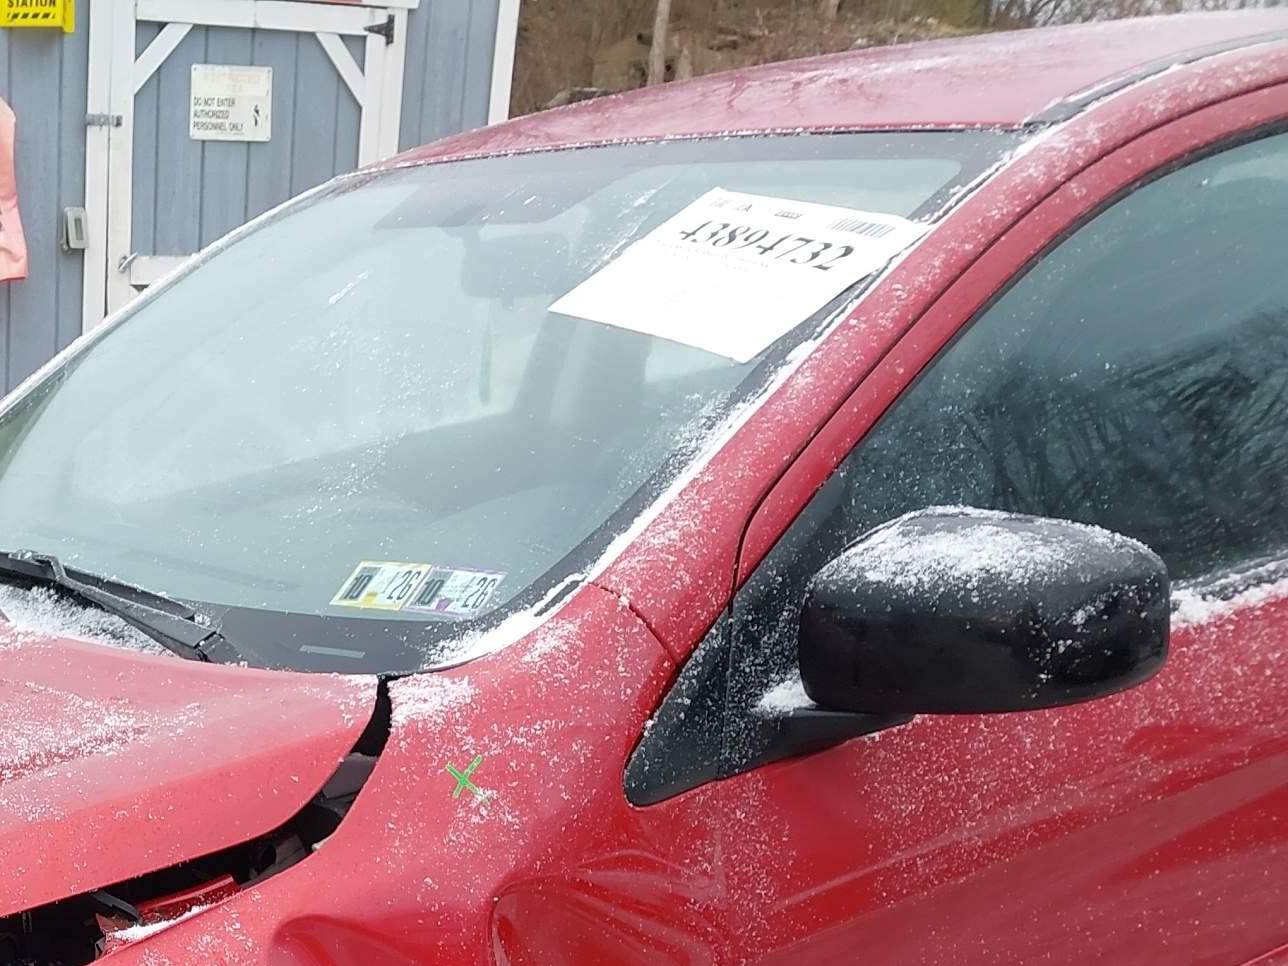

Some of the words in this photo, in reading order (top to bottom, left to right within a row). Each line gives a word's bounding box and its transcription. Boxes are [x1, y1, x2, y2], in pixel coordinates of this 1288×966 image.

[193, 96, 202, 106] DO
[204, 97, 216, 106] NOT
[217, 97, 236, 107] ENTER
[193, 108, 230, 119] AUTHORIZED
[193, 121, 227, 131] PERSONNEL
[228, 122, 244, 131] ONLY
[679, 220, 854, 271] 43894732
